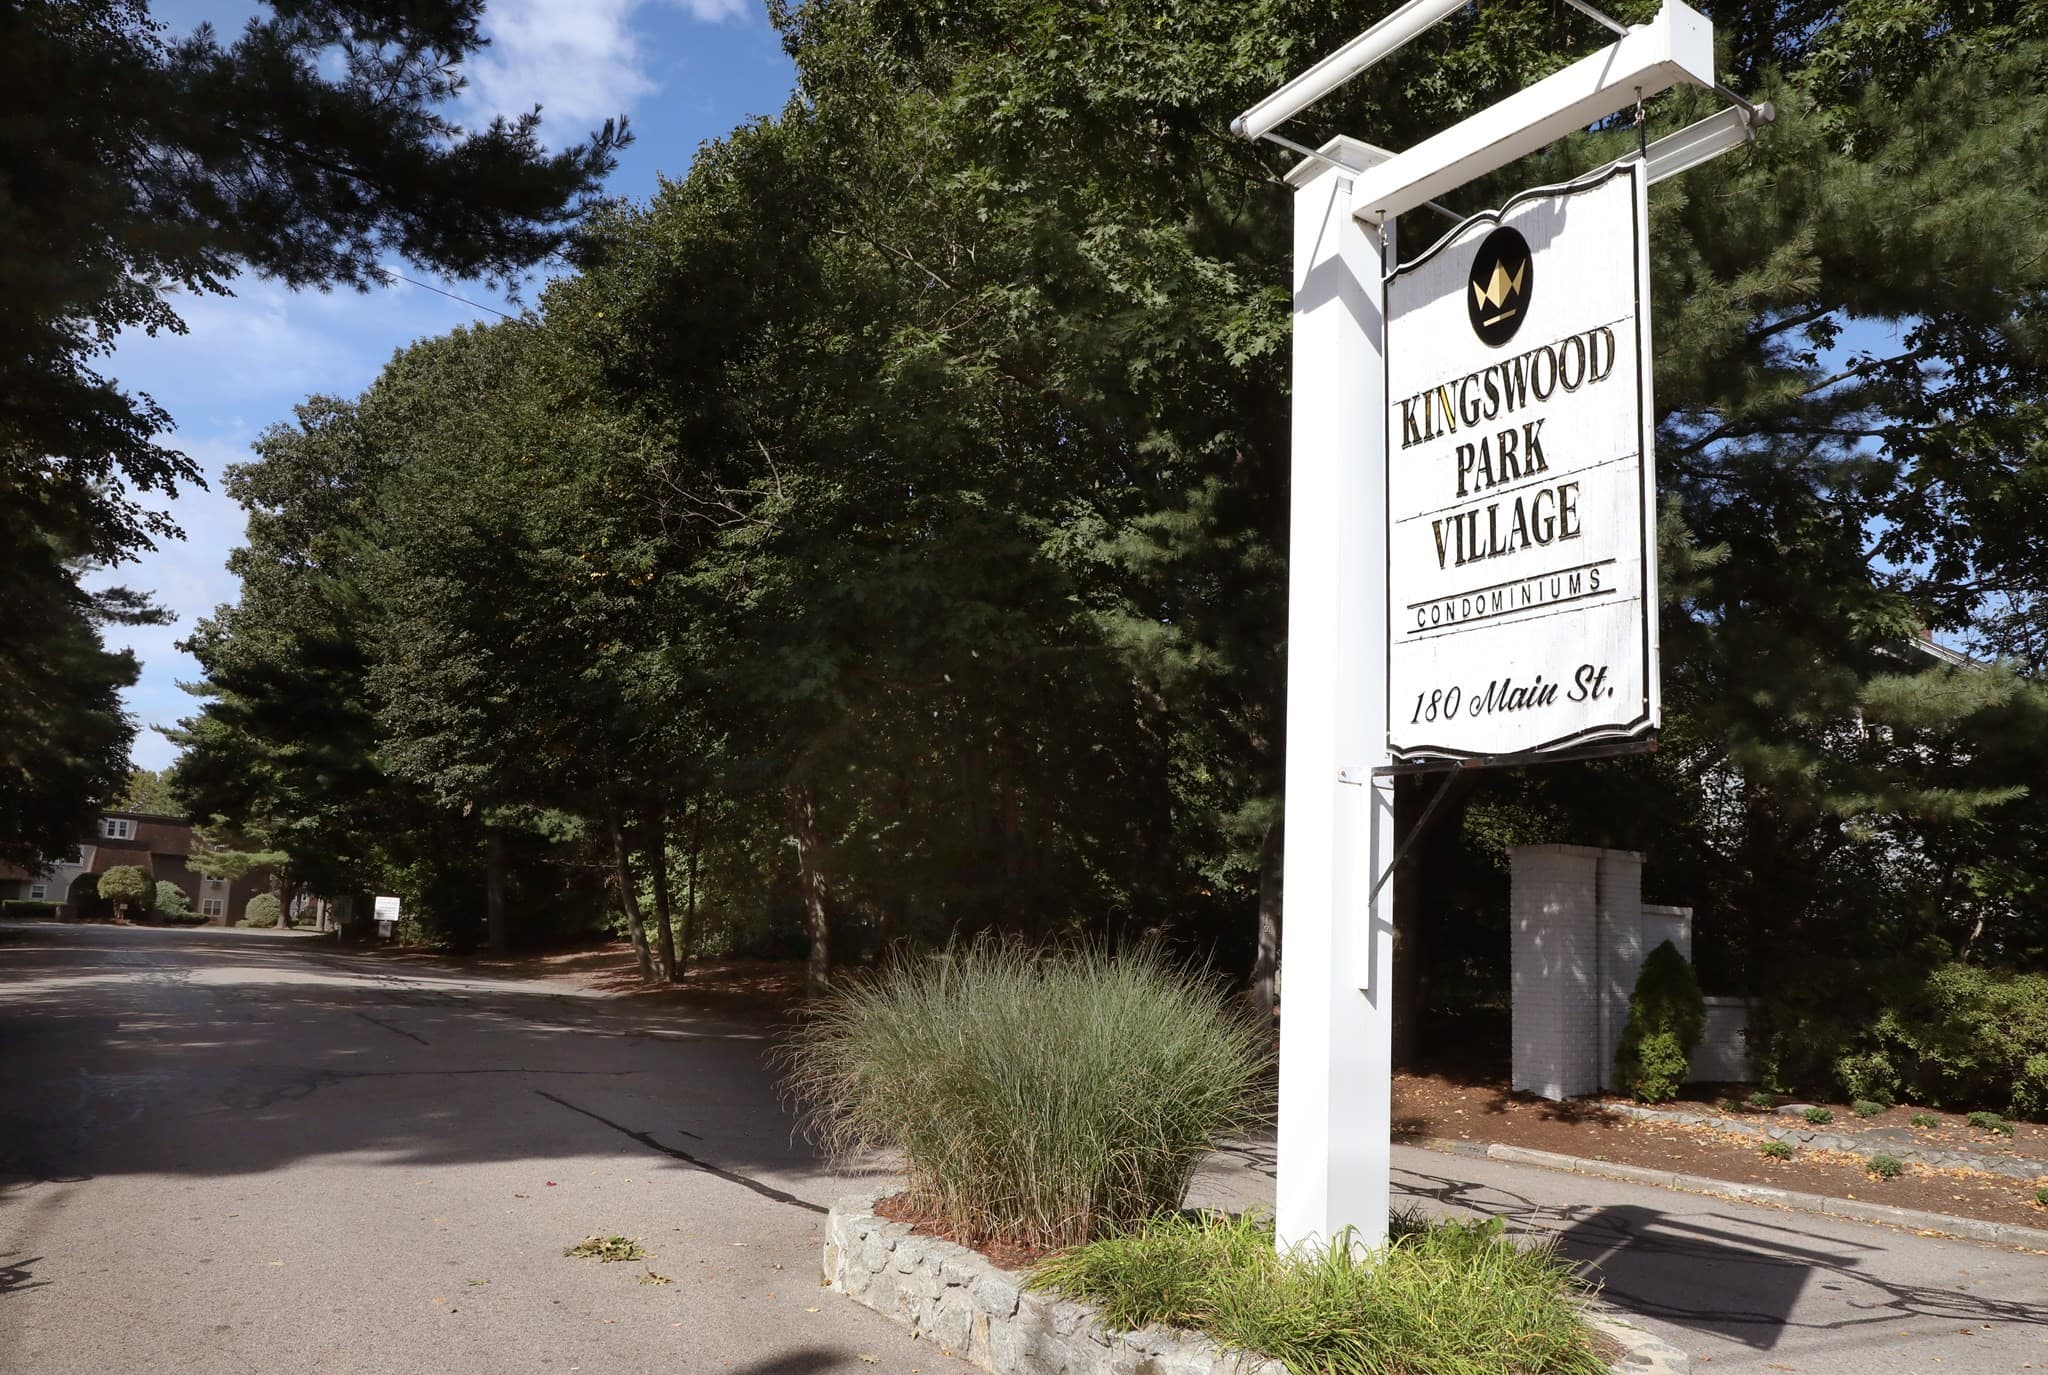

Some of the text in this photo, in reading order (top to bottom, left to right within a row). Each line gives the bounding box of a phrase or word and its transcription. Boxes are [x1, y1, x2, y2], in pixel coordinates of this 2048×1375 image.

[1401, 326, 1615, 450] KINGSWOOD
[1456, 418, 1548, 497] PARK
[1432, 481, 1582, 569] VILLAGE
[1417, 568, 1600, 628] CONDOMINIUMS
[1410, 664, 1614, 724] 180 Main St.
